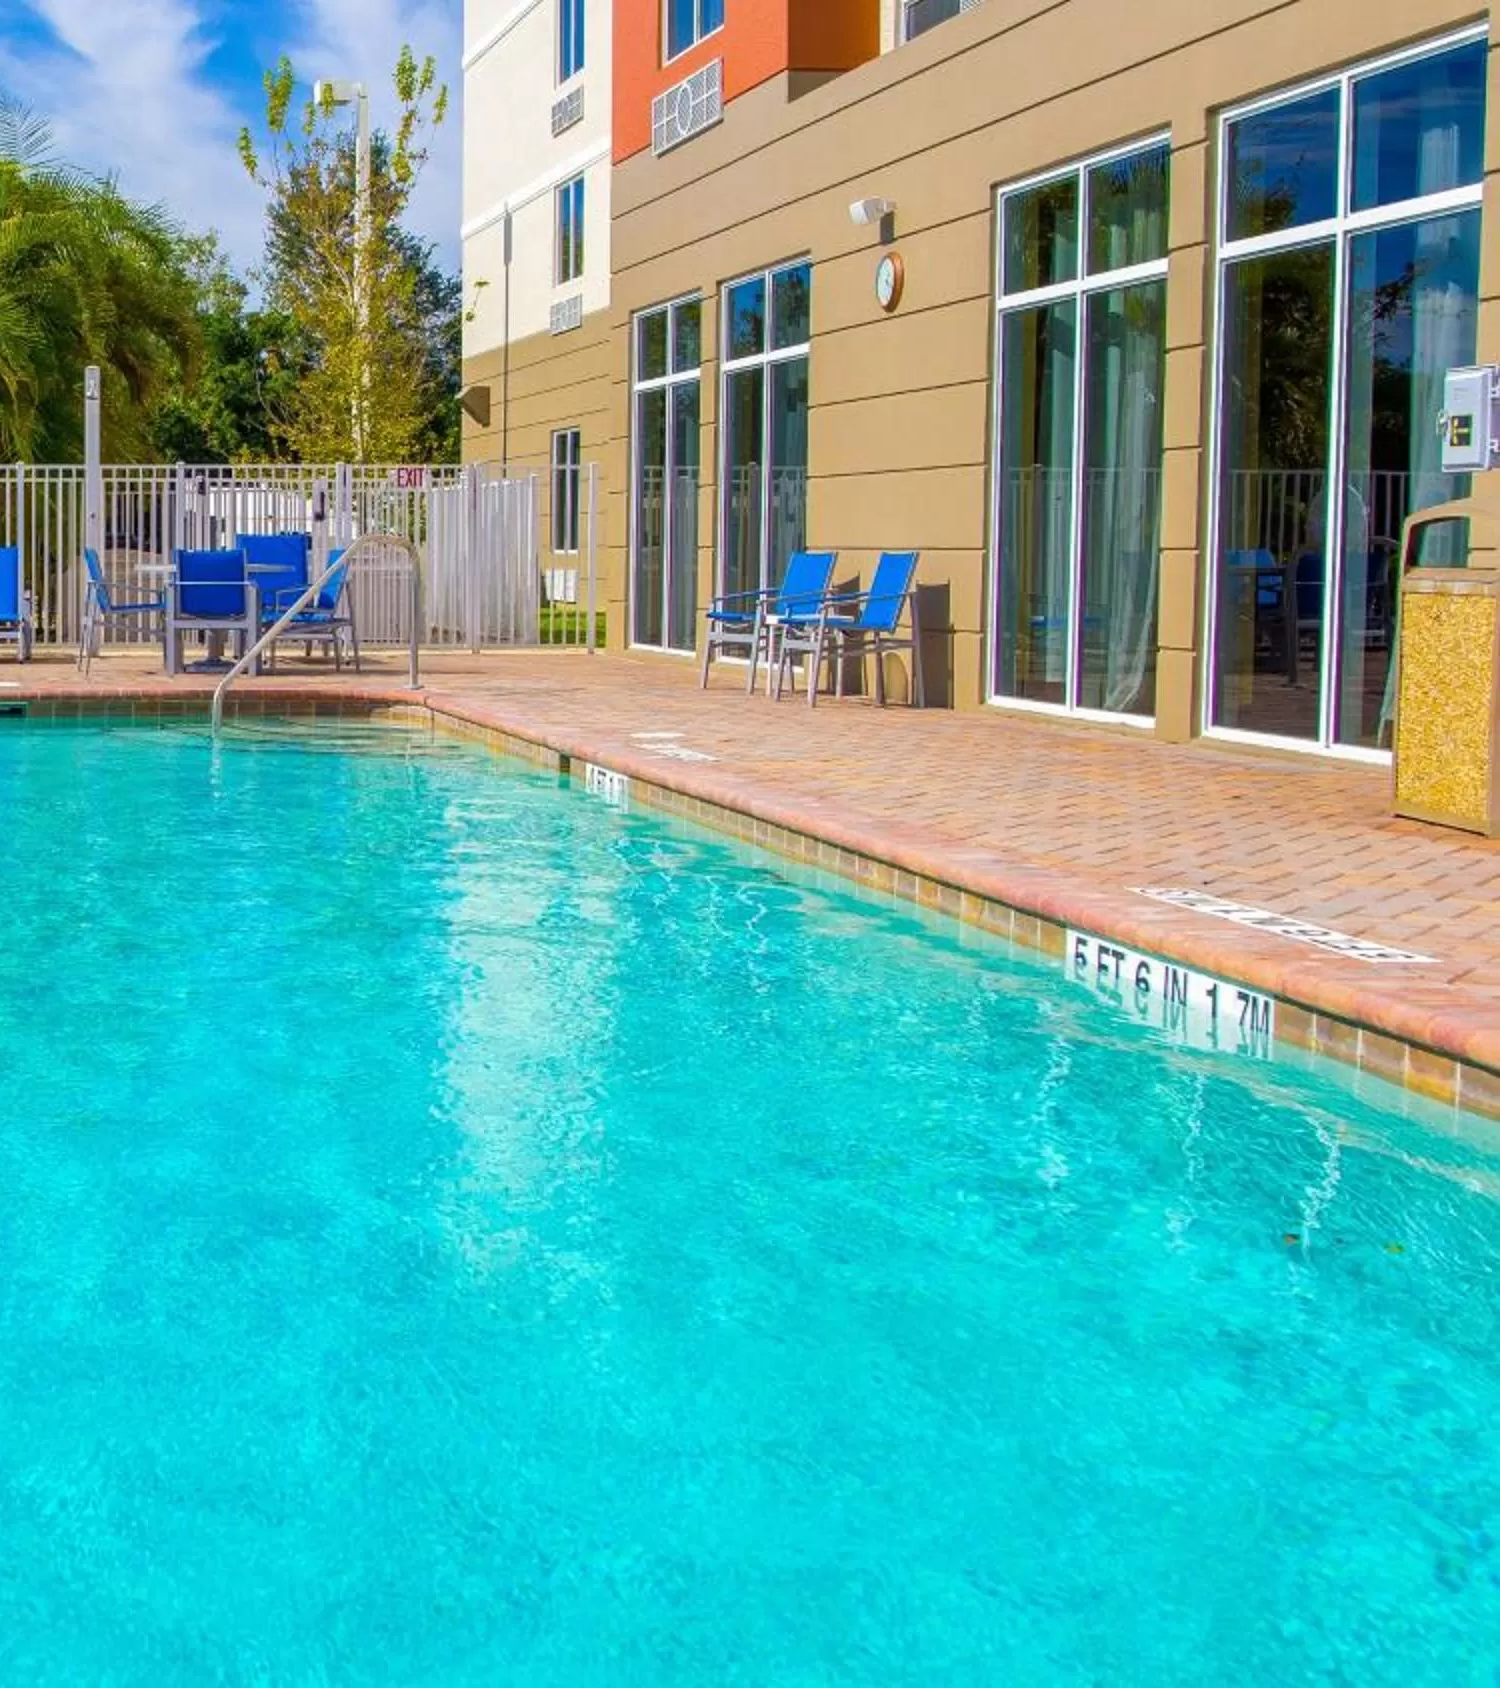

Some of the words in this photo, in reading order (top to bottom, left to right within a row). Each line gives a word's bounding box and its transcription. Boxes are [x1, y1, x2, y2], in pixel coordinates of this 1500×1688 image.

[397, 467, 424, 488] EXIT
[1097, 943, 1126, 980] FT
[1134, 960, 1152, 992] 6
[1163, 965, 1189, 1008] IN
[1205, 983, 1220, 1019] 1
